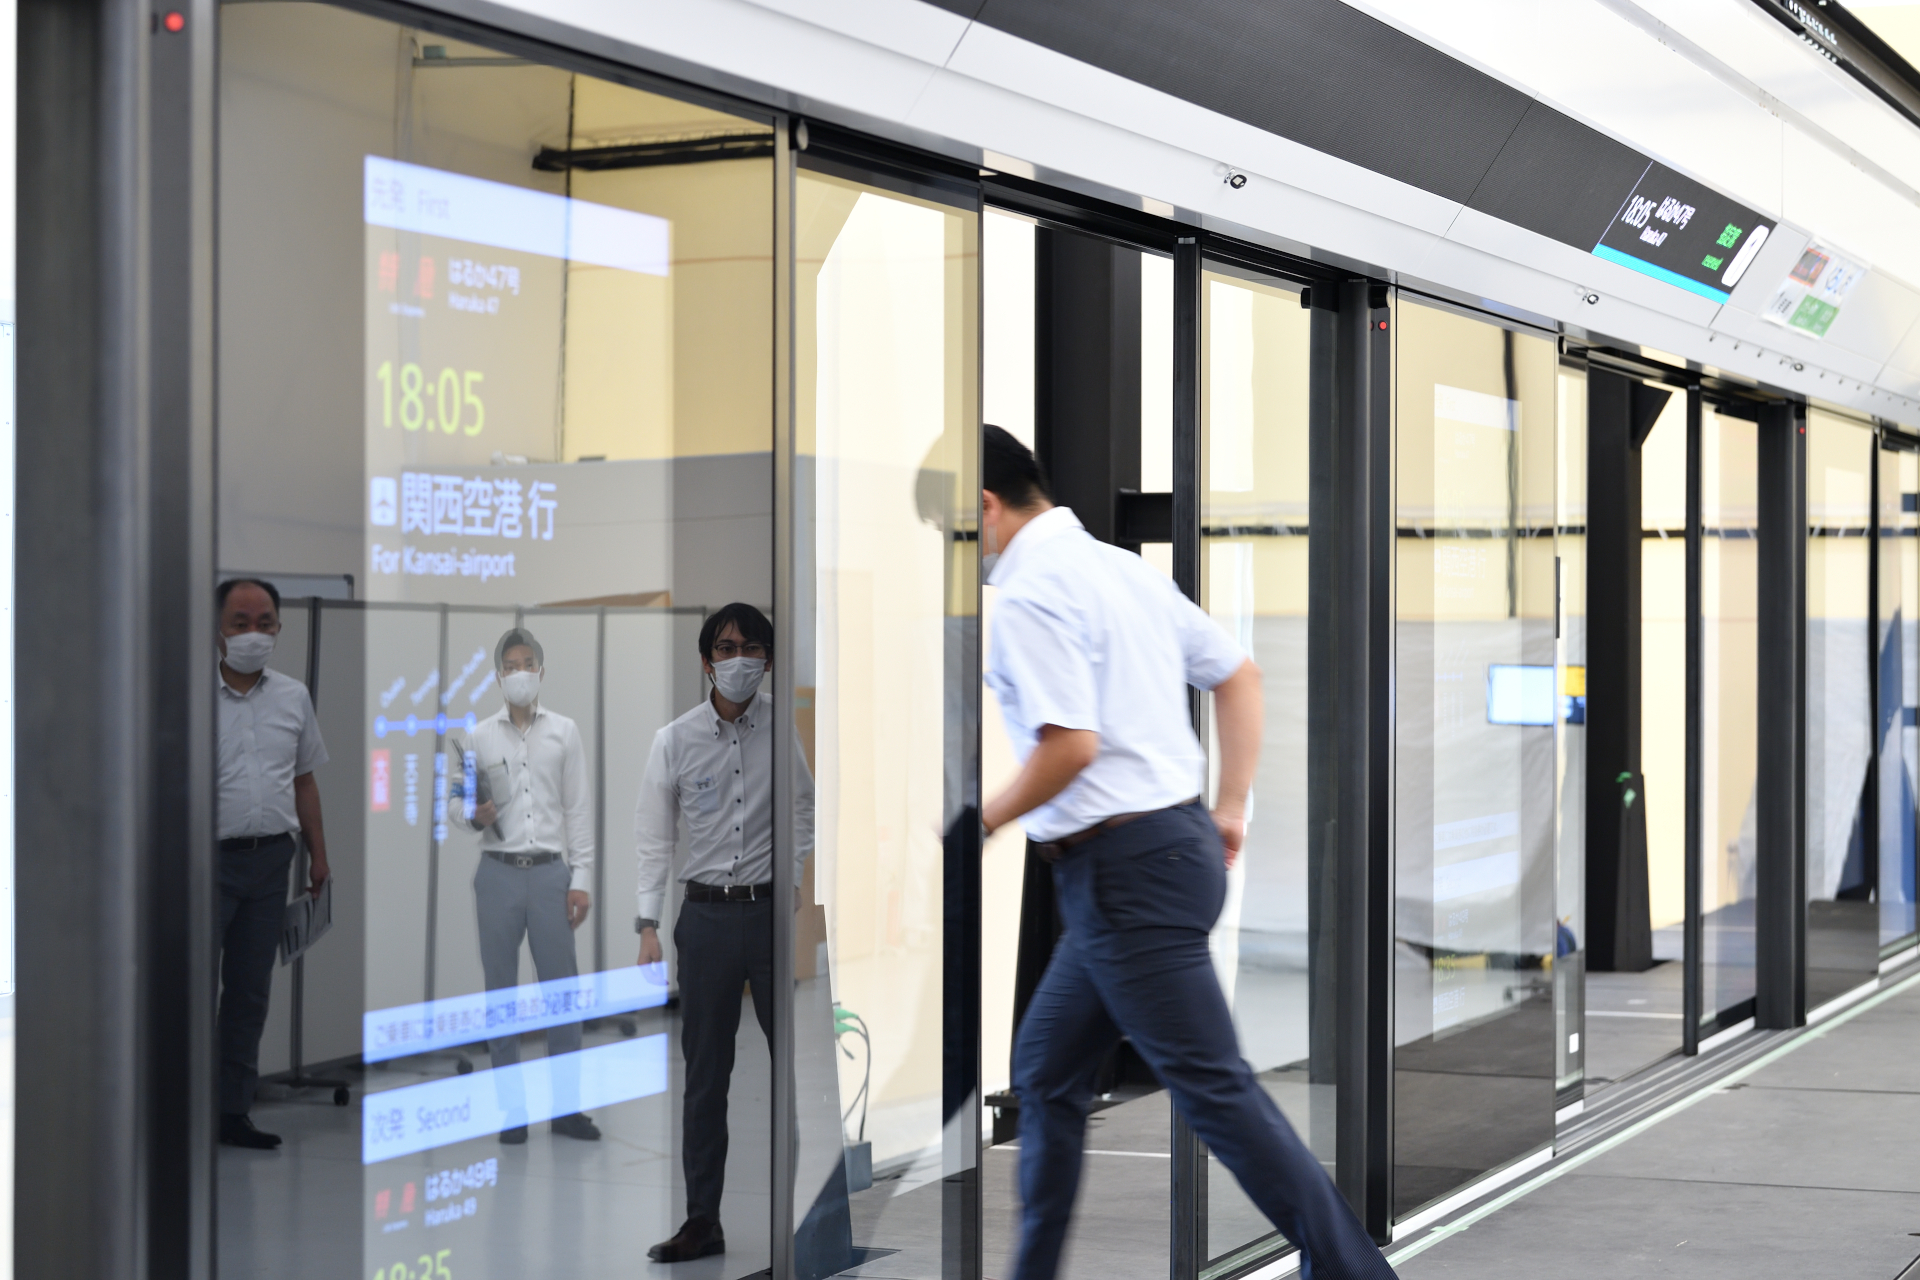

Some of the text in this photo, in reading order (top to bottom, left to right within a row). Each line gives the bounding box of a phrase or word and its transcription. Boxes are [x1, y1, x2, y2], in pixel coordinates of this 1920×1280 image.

[1621, 194, 1657, 229] 18:05
[377, 360, 485, 437] 18:05
[401, 471, 558, 541] 関西空港行
[371, 544, 516, 583] For Kansai-airport
[416, 1096, 471, 1133] Second
